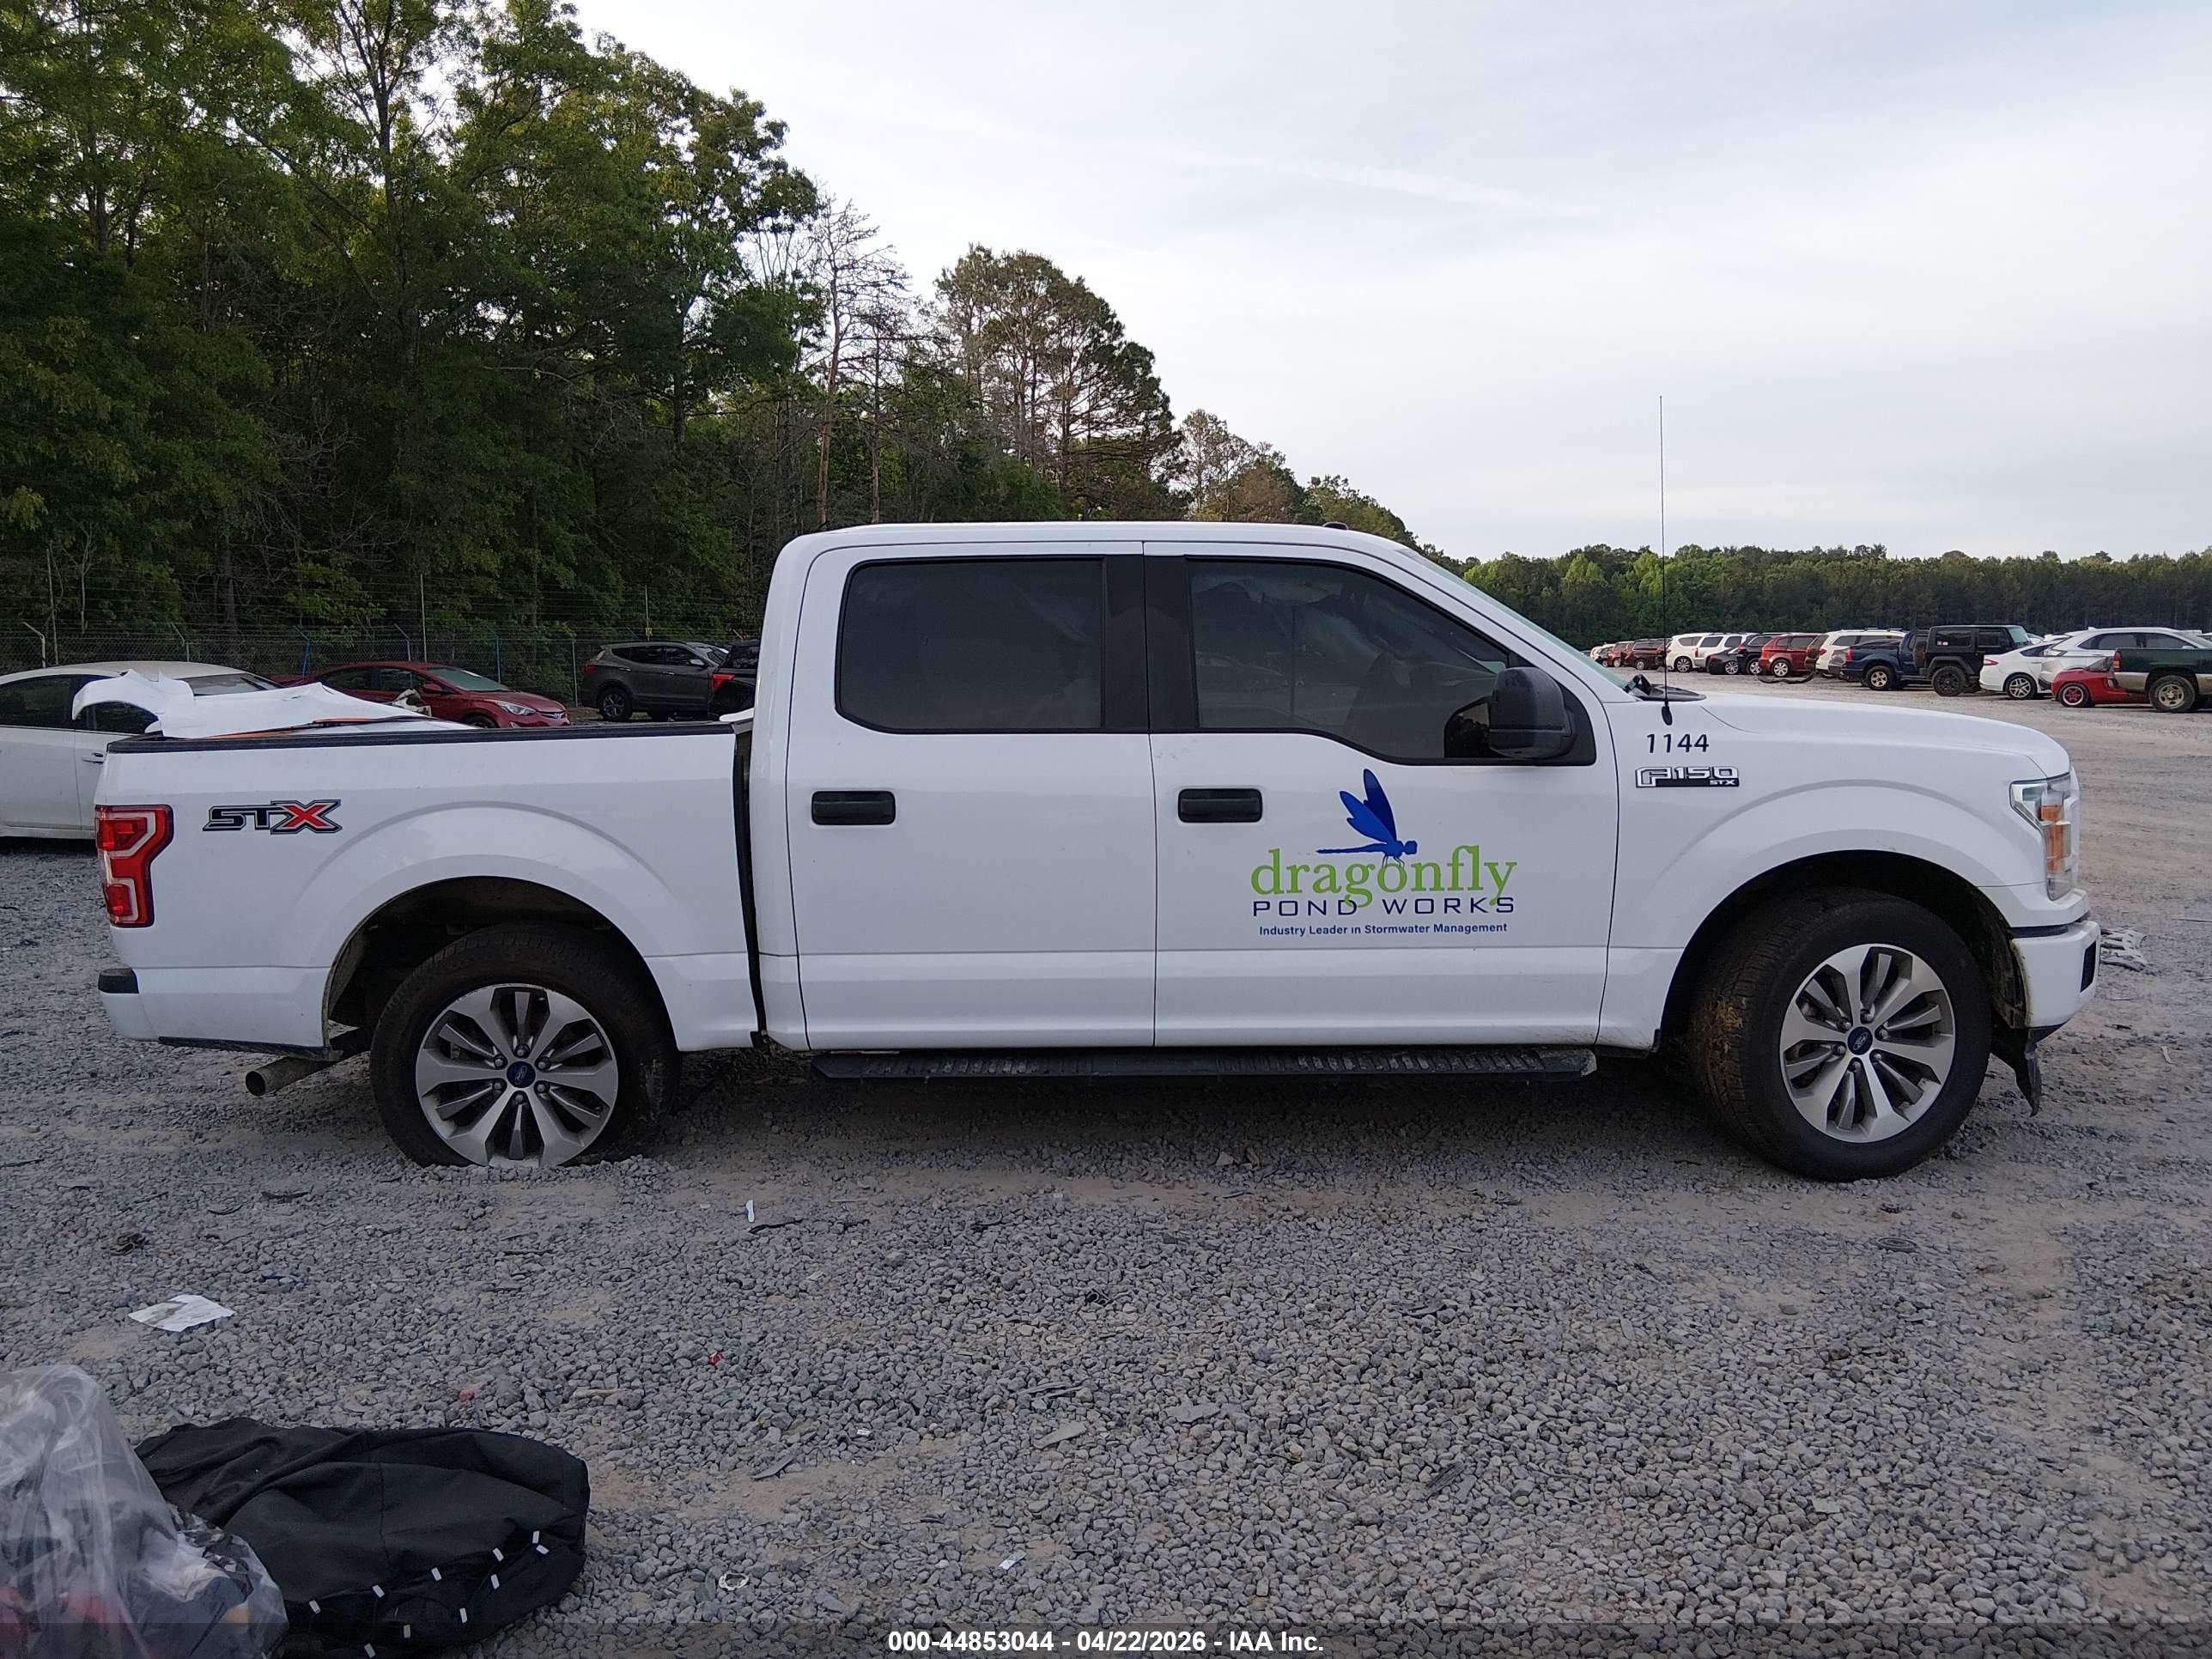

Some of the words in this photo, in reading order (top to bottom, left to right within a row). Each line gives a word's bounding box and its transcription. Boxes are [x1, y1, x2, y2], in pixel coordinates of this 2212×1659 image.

[1646, 733, 1710, 753] 1144
[202, 799, 343, 836] STX
[1250, 844, 1518, 908] dragonfly
[1252, 898, 1358, 917] POND
[1382, 896, 1515, 915] WORKS
[1259, 925, 1306, 937] Industry
[1309, 925, 1349, 935] Leader
[1351, 926, 1362, 935] in
[1364, 924, 1430, 935] Stormwater
[1433, 923, 1508, 936] Management
